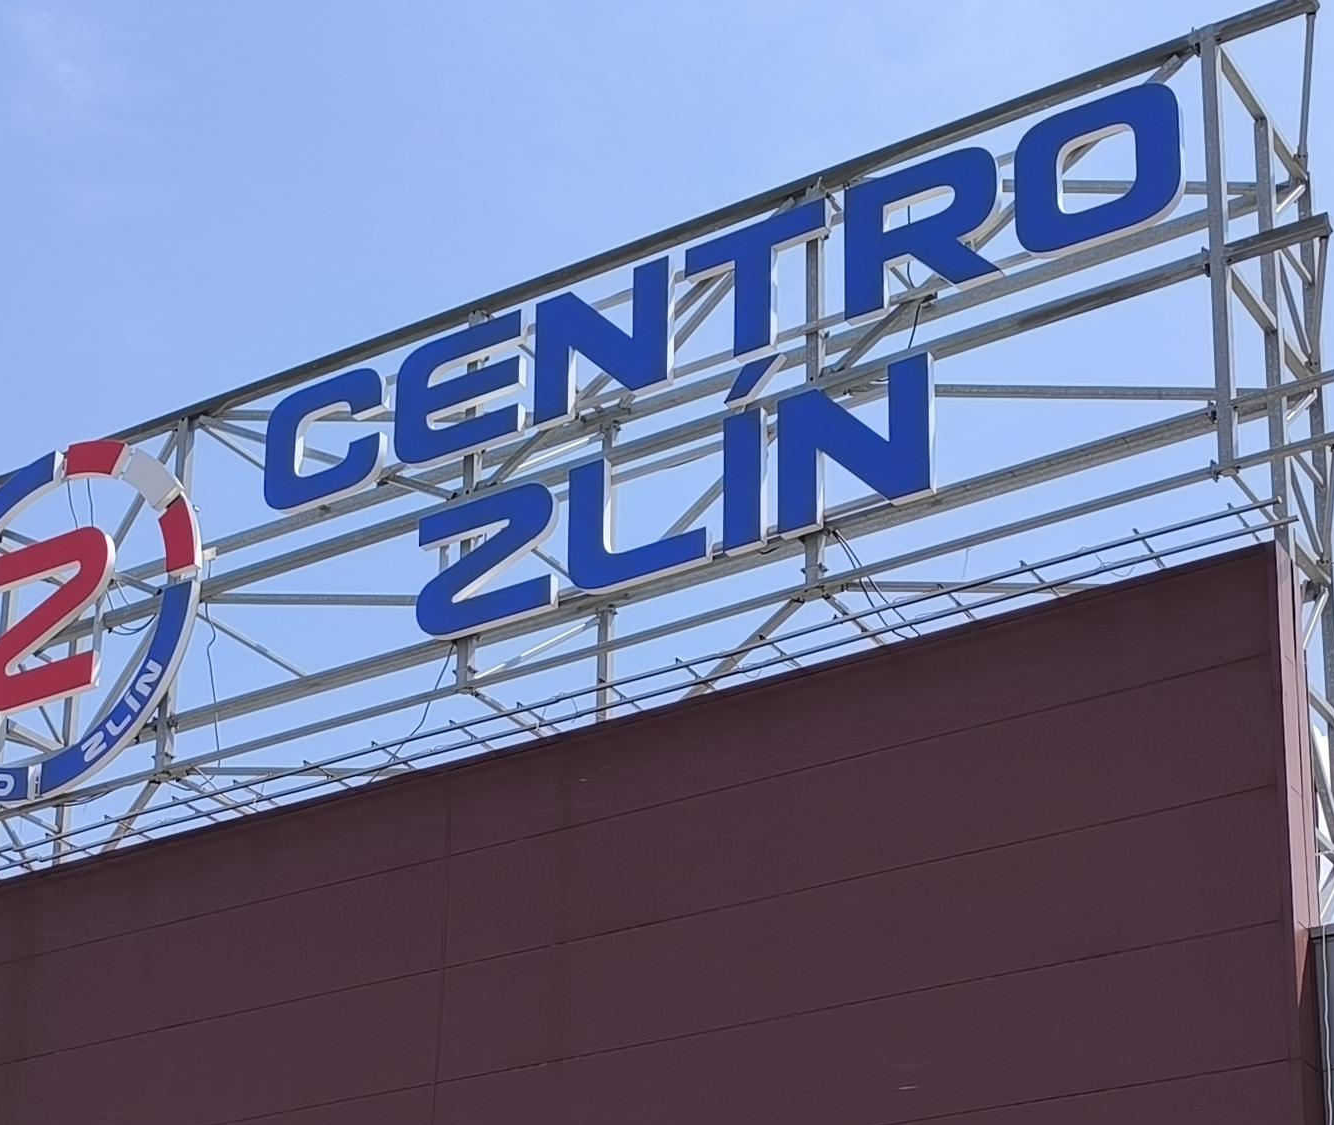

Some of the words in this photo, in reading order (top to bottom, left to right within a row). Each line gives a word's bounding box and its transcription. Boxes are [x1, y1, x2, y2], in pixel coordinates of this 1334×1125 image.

[264, 83, 1184, 512] CENTRO
[414, 352, 937, 640] ZLÍN
[80, 658, 163, 763] ZLÍN
